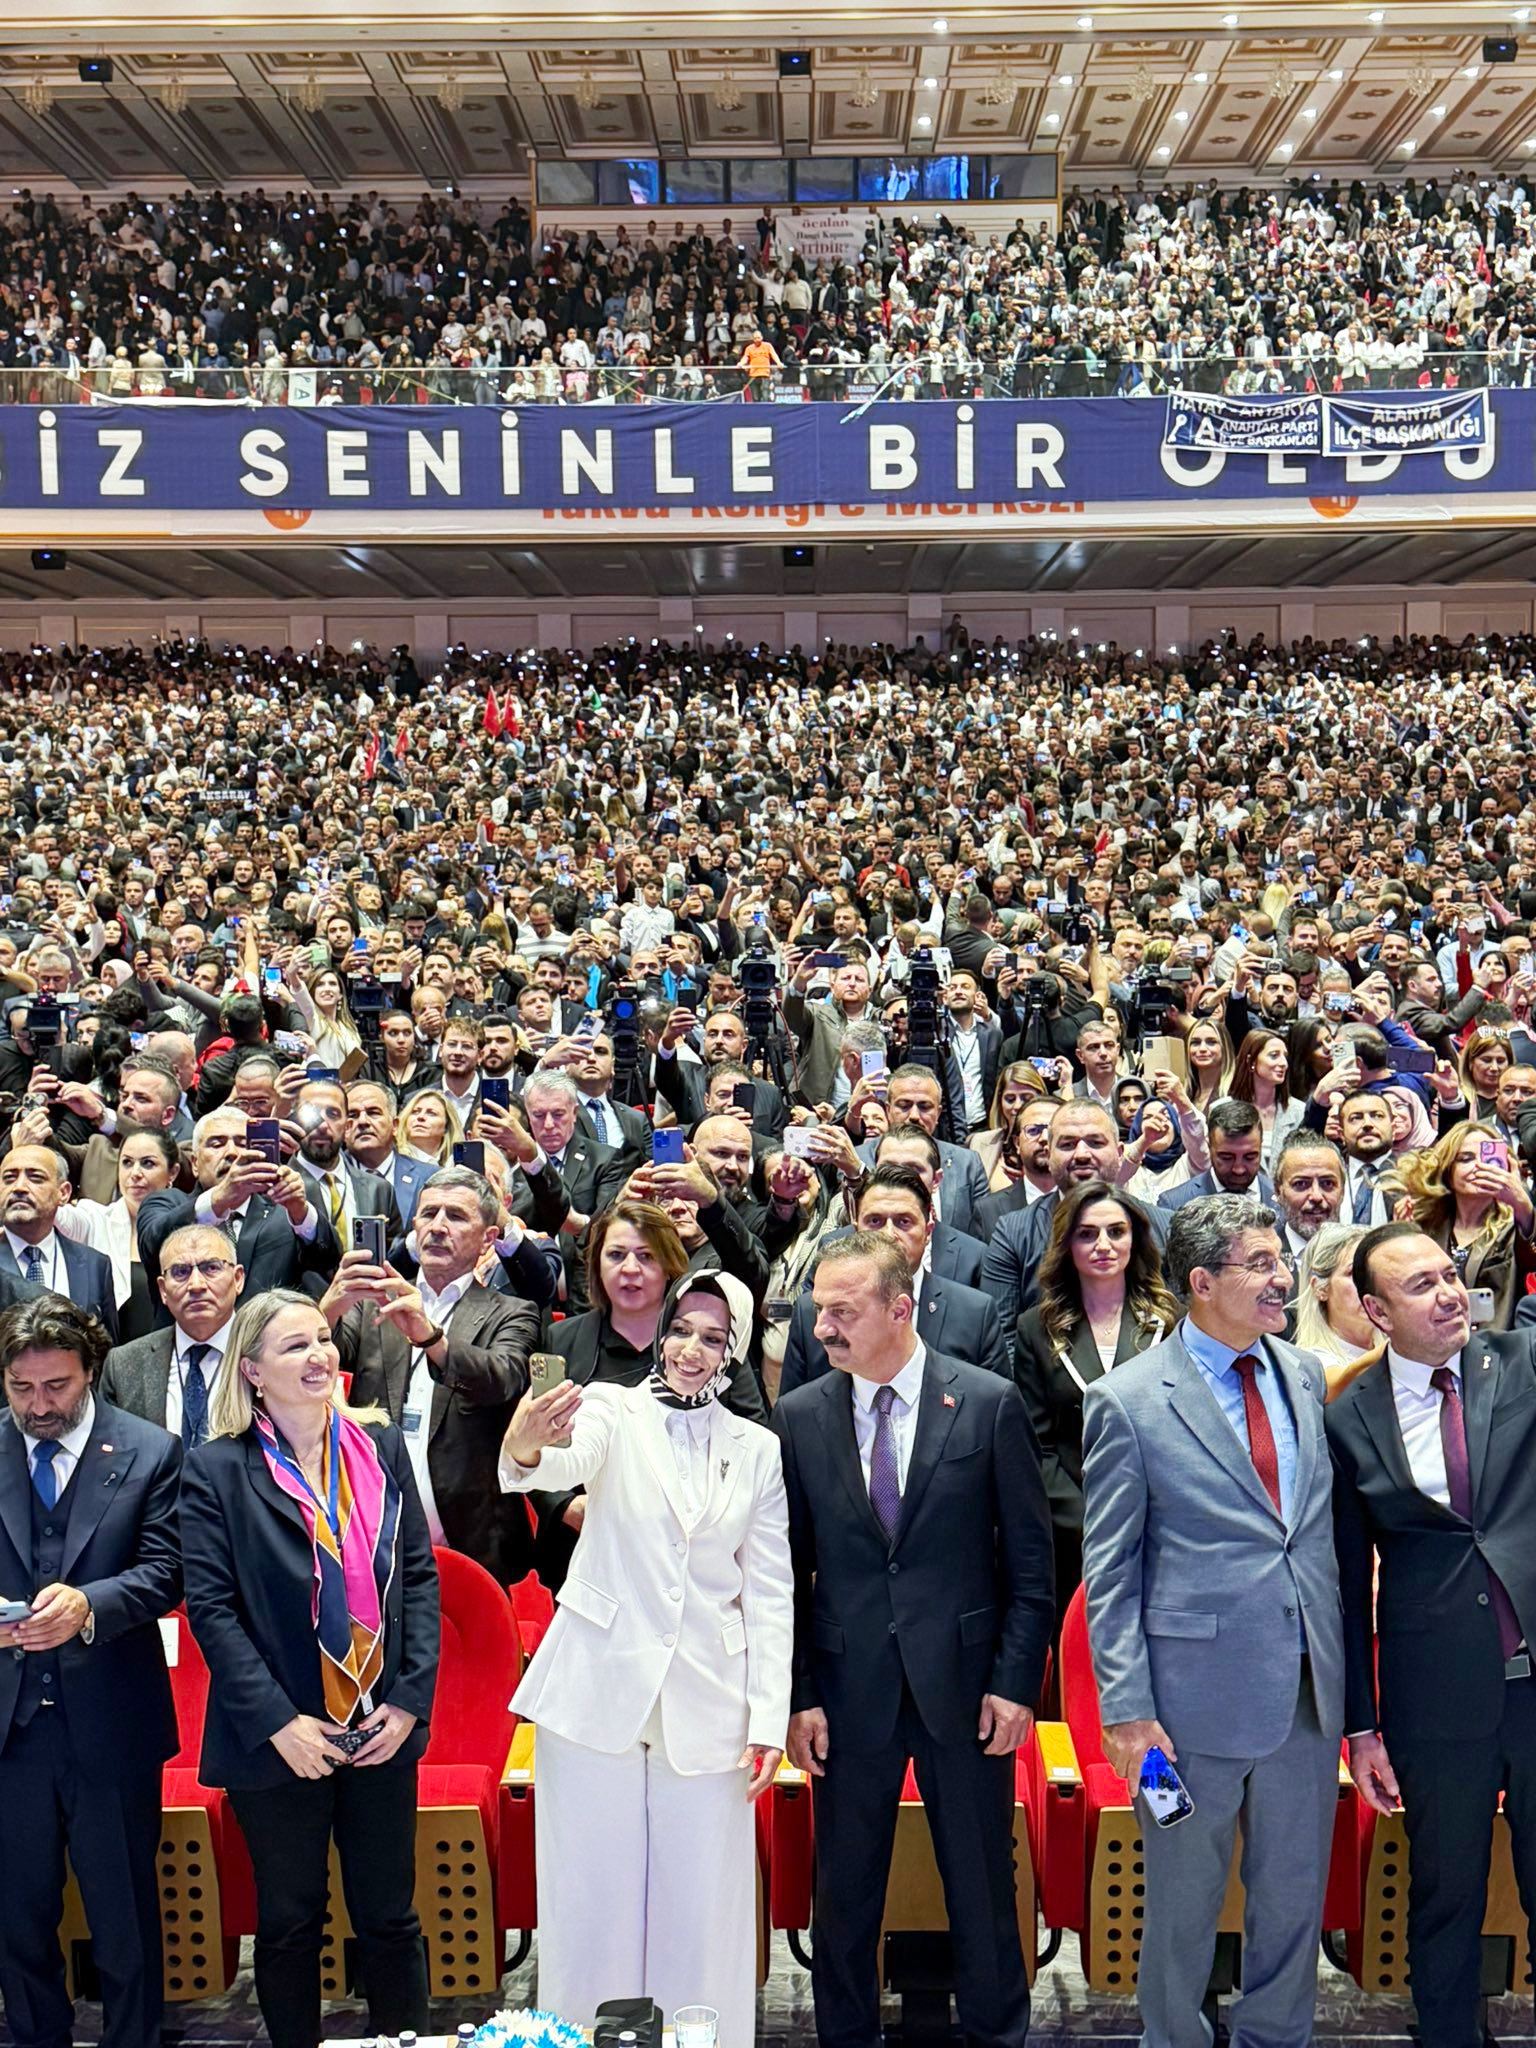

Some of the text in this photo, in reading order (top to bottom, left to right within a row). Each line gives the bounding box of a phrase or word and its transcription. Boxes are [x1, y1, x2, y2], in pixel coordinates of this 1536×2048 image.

[802, 217, 849, 228] öcalan
[1172, 396, 1227, 415] HATAY
[1219, 420, 1319, 433] ANAHTAR PARTİ
[1334, 413, 1481, 449] İLÇE BAŞKANLIĞI
[1247, 434, 1318, 448] BAŞKANLIĞI
[0, 411, 145, 495] İZ
[240, 411, 774, 496] SENİNLE
[869, 404, 1066, 490] BİR
